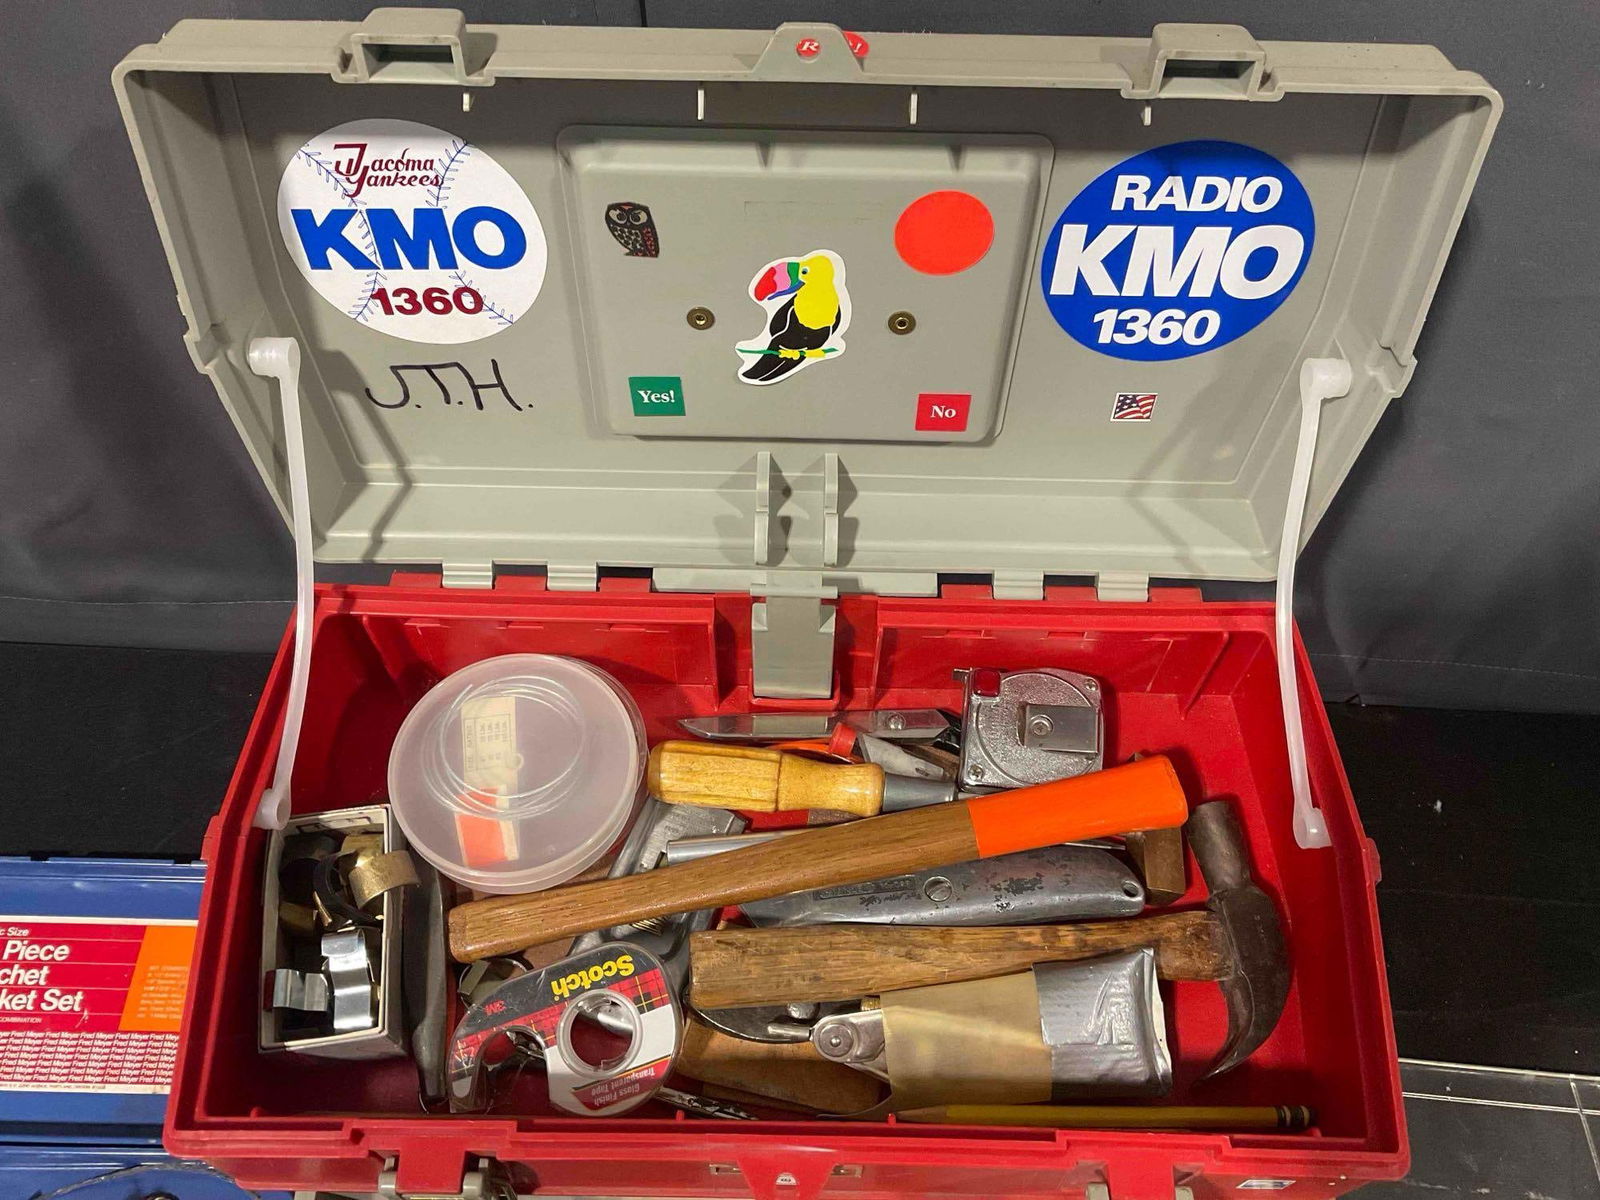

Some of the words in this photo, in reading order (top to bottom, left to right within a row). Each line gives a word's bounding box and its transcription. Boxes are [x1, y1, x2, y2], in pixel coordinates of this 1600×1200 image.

[334, 143, 434, 176] Tacoma
[345, 165, 440, 198] Yankees
[1111, 174, 1283, 214] RADIO
[290, 205, 527, 270] KMO
[1049, 224, 1305, 300] KMO
[370, 286, 485, 316] 1360
[1092, 308, 1221, 346] 1360
[637, 389, 676, 404] Yes!
[930, 404, 957, 420] No
[7, 926, 30, 937] Size
[2, 940, 71, 961] Piece
[551, 955, 635, 1000] Scotch
[40, 988, 85, 1012] Set
[591, 1082, 610, 1096] Tape
[611, 1067, 656, 1090] Transparent
[618, 1083, 640, 1097] Gloss
[593, 1092, 618, 1107] Finish
